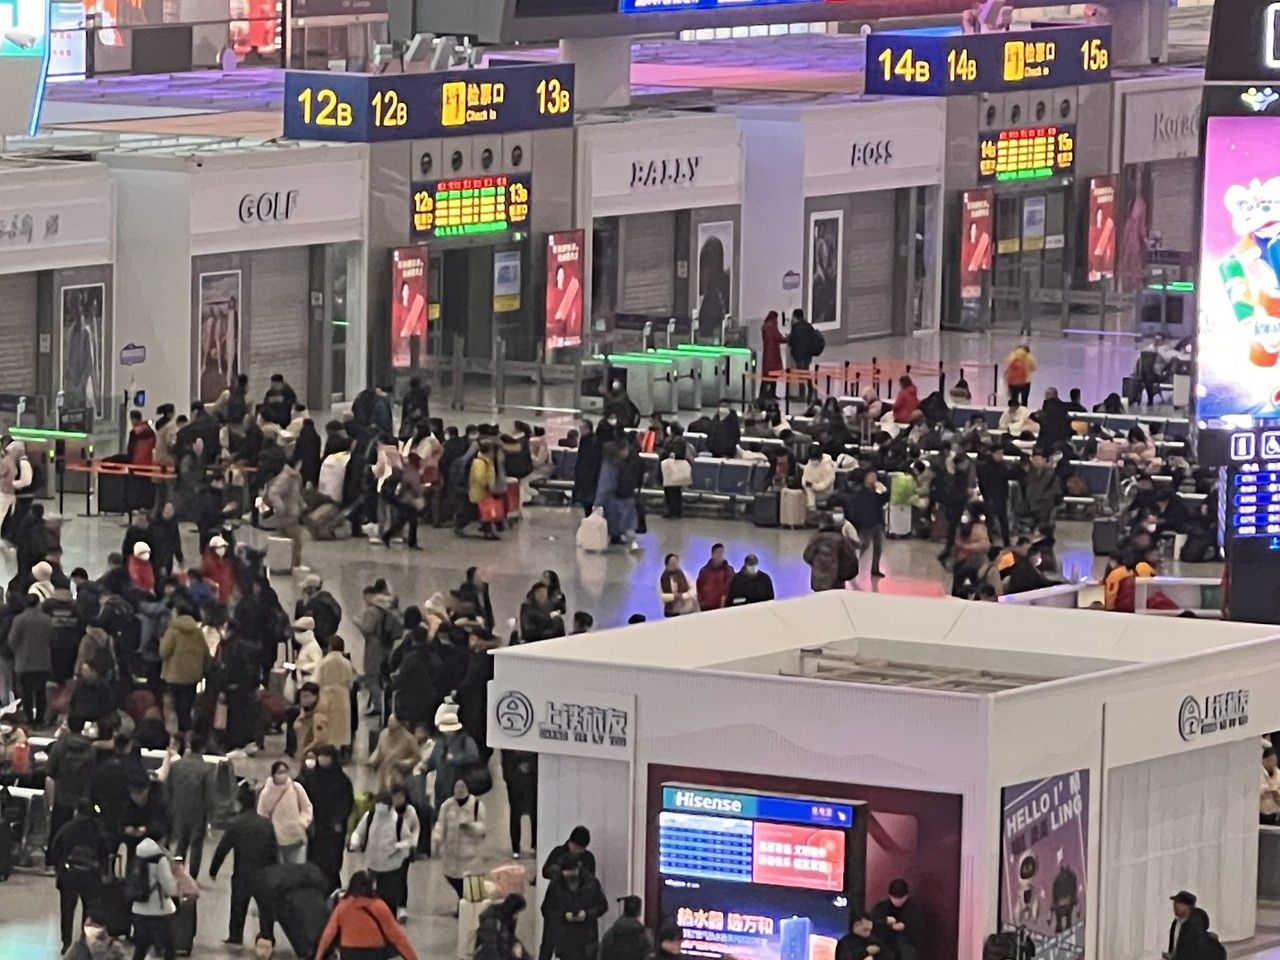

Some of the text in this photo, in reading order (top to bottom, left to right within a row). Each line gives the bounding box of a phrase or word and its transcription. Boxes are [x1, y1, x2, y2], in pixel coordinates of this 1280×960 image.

[878, 48, 930, 82] 14B
[947, 49, 977, 81] 14B
[1080, 39, 1108, 70] 15B
[297, 87, 353, 127] 12B
[371, 89, 408, 127] 12B
[536, 78, 571, 115] 13B
[675, 790, 743, 813] Hisense
[1006, 793, 1050, 838] HELLO
